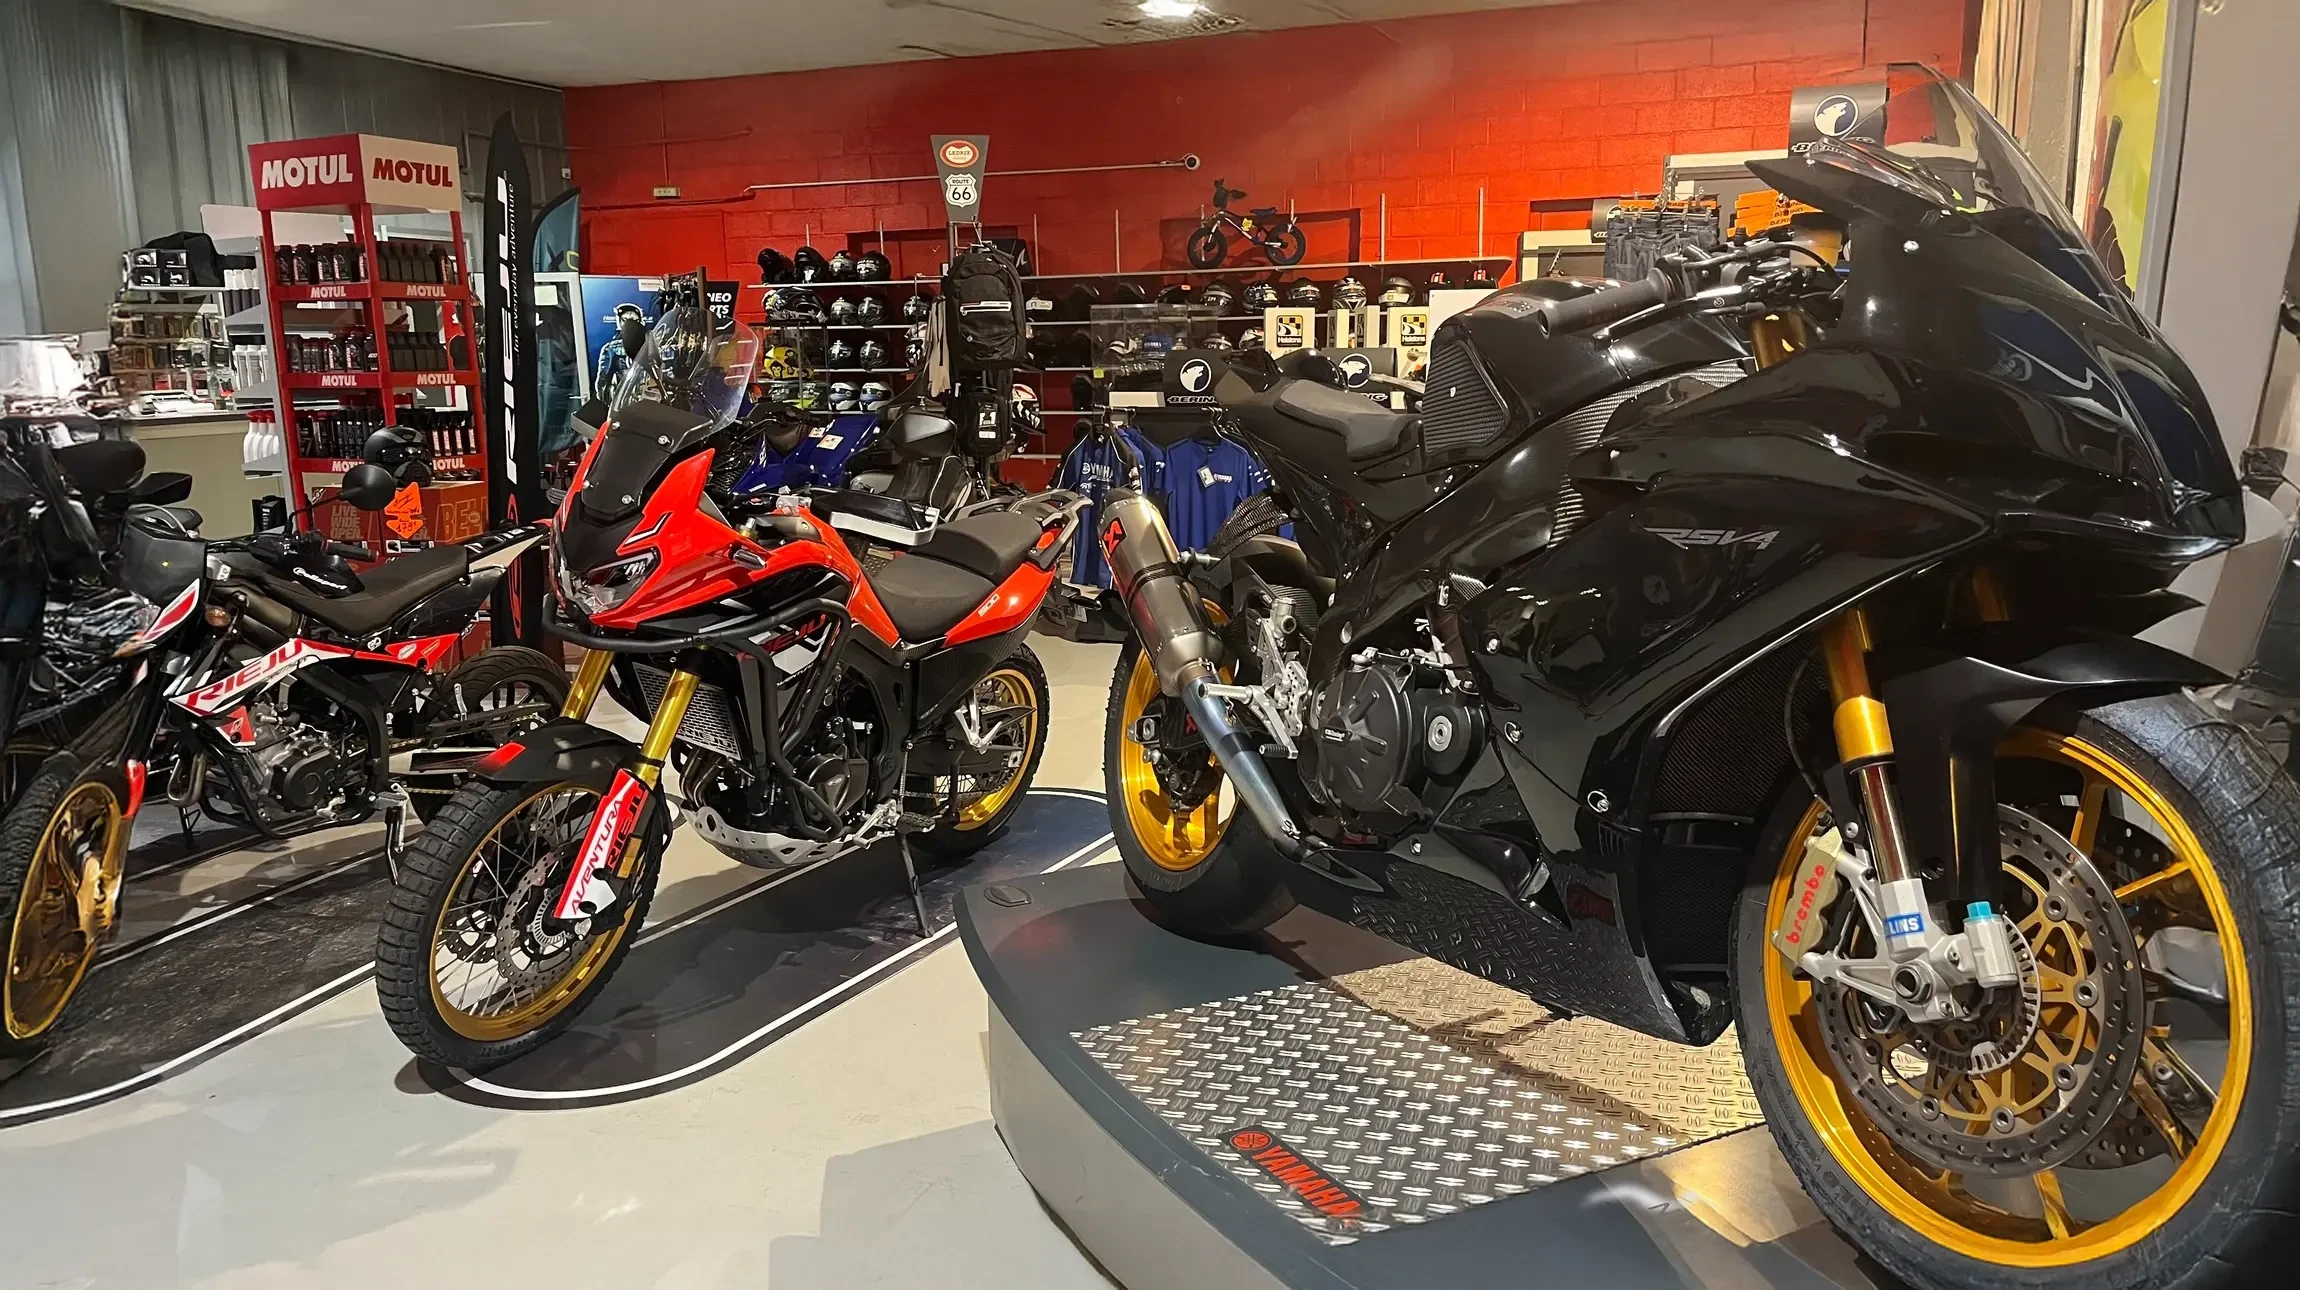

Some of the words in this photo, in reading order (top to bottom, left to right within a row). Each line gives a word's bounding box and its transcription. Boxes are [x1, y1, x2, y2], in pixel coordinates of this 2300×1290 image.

[261, 153, 353, 190] MOTUL
[373, 157, 453, 188] MOTUL
[952, 187, 971, 201] 66
[507, 183, 516, 259] adventure
[311, 286, 346, 298] MOTUL
[406, 284, 446, 297] MOTUL
[509, 263, 519, 328] everyday
[498, 176, 517, 485] RIEJU
[321, 374, 358, 387] MOTUL
[417, 373, 456, 385] MOTUL
[1167, 395, 1219, 404] BERIN
[332, 461, 365, 472] MOT
[331, 516, 360, 528] WIDE
[332, 504, 357, 517] LIVE
[330, 527, 363, 540] OPEN.
[977, 592, 1001, 618] 500
[186, 639, 303, 706] RIEJU
[607, 782, 648, 870] RIEJU
[571, 800, 623, 916] AVENTURA
[1786, 864, 1826, 944] brembo
[1252, 1145, 1363, 1218] YAMAHA
